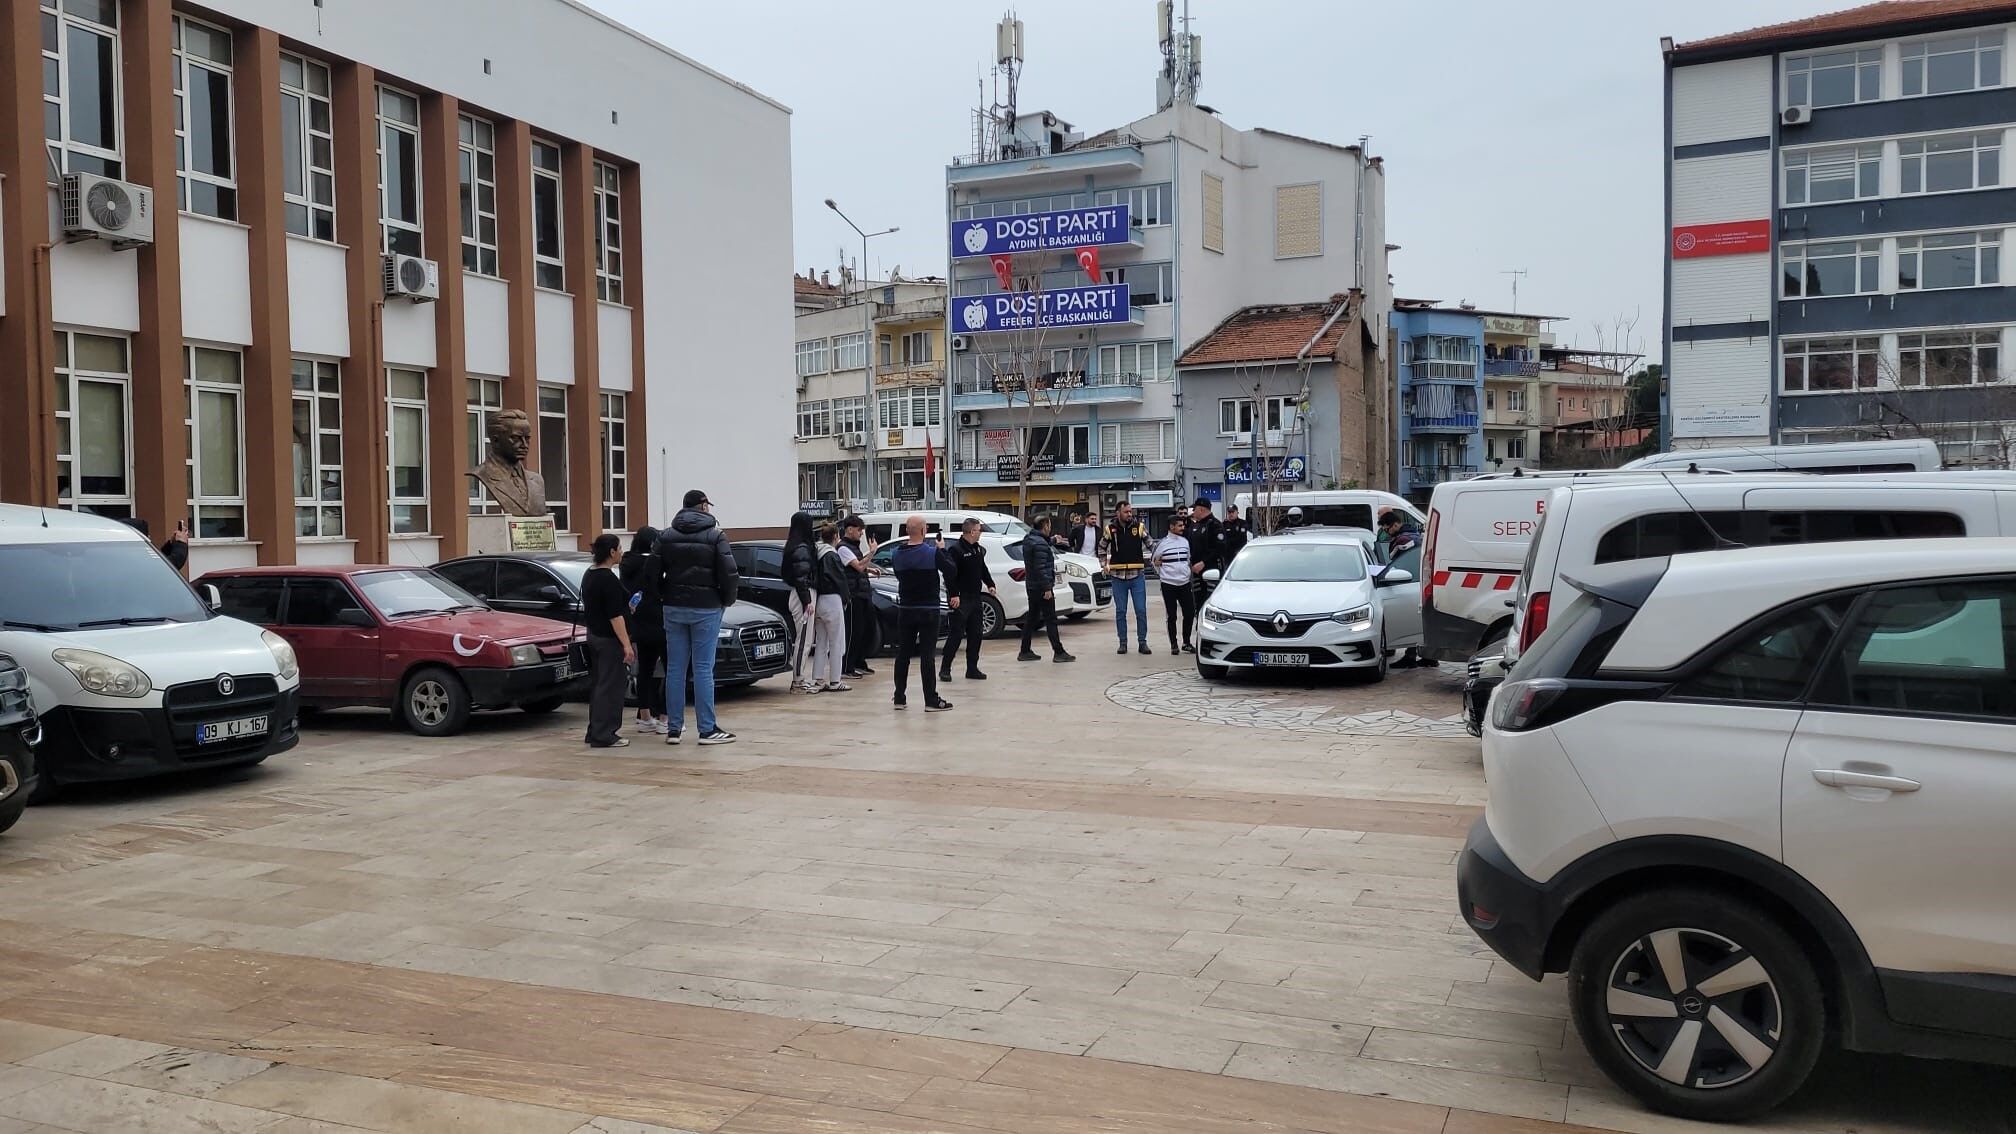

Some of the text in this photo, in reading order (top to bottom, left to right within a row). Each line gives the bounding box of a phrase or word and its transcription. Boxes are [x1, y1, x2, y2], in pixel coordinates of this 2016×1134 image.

[996, 216, 1051, 239] DOST
[1009, 238, 1036, 250] AYDIN
[1049, 231, 1105, 246] BAŞKANLIĞI
[996, 294, 1051, 315] DOST
[1000, 315, 1032, 327] EFELER
[1291, 654, 1306, 663] 927
[204, 725, 217, 738] 09
[227, 722, 240, 735] KJ
[250, 717, 267, 731] 167
